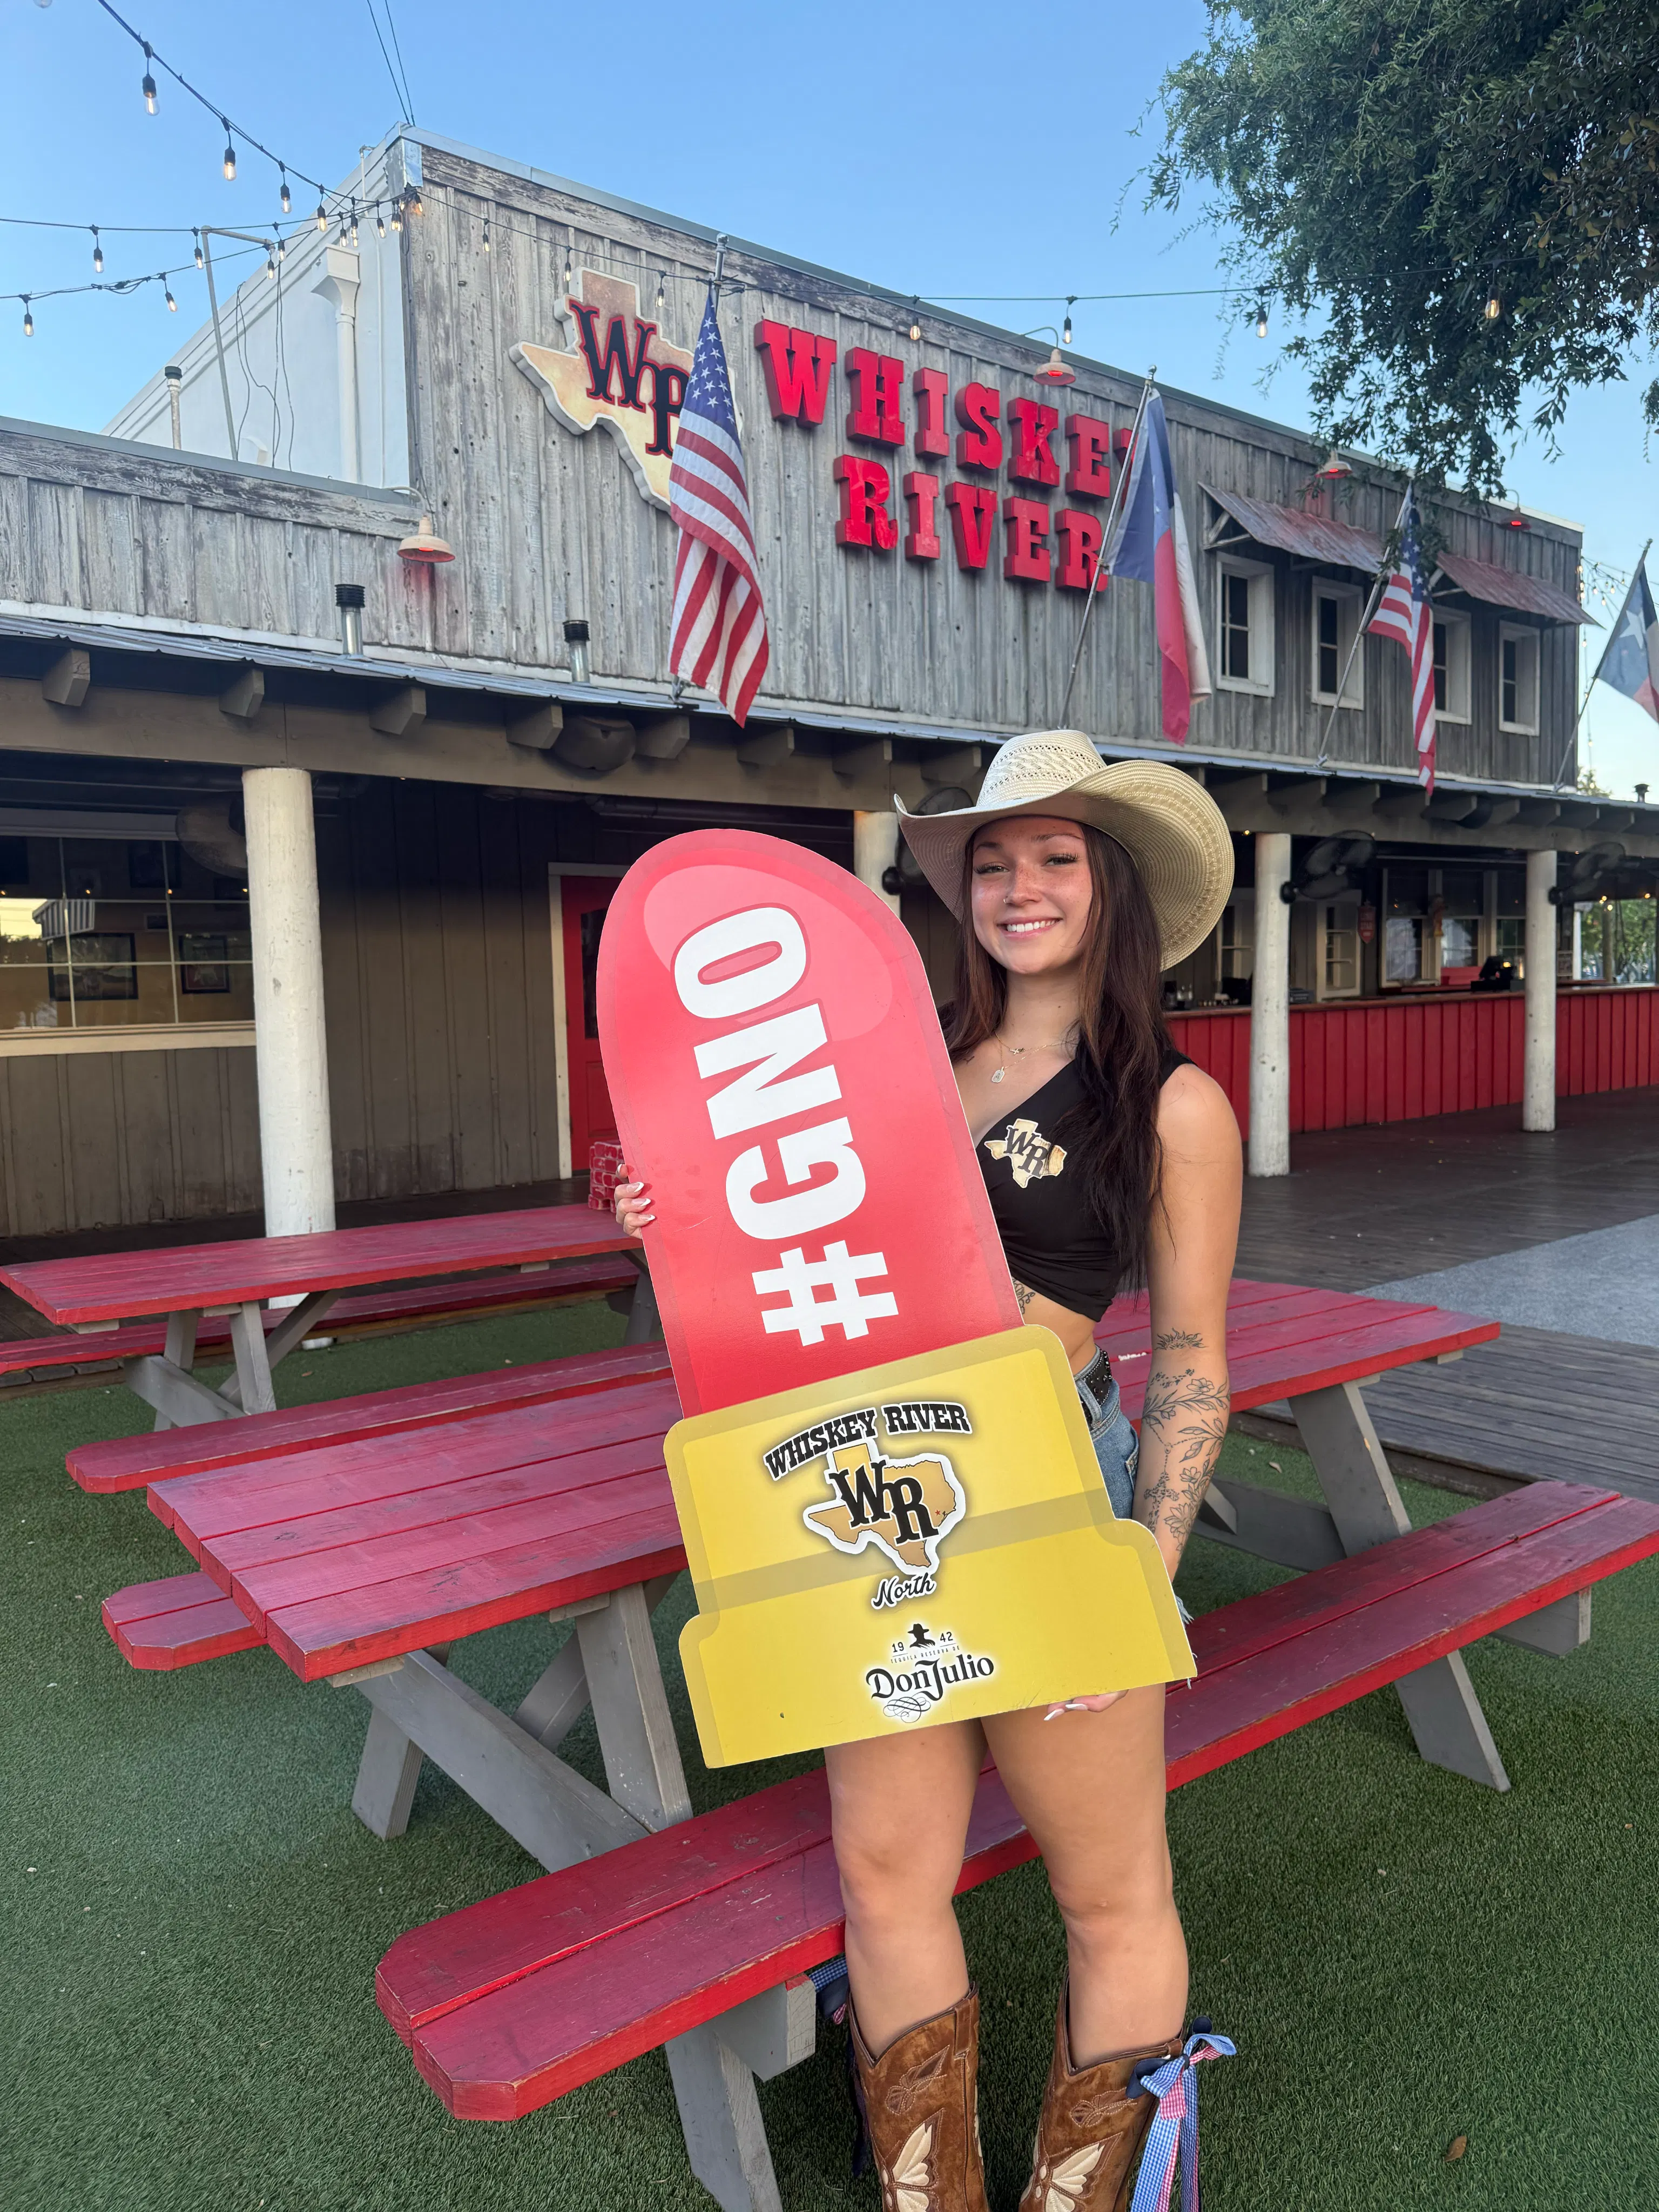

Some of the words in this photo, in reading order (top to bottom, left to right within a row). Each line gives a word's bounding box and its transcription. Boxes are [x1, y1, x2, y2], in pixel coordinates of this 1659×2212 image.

[833, 454, 1109, 592] RIVER
[674, 907, 899, 1347] #GNO
[1003, 1127, 1049, 1178] WR
[765, 1410, 875, 1479] WHISKEY
[884, 1404, 970, 1433] RIVER
[829, 1460, 940, 1545] WR
[873, 1572, 935, 1607] North
[891, 1655, 917, 1664] TEQUILA
[921, 1648, 949, 1658] RESERVA
[892, 1642, 905, 1653] 19
[940, 1631, 953, 1642] 42
